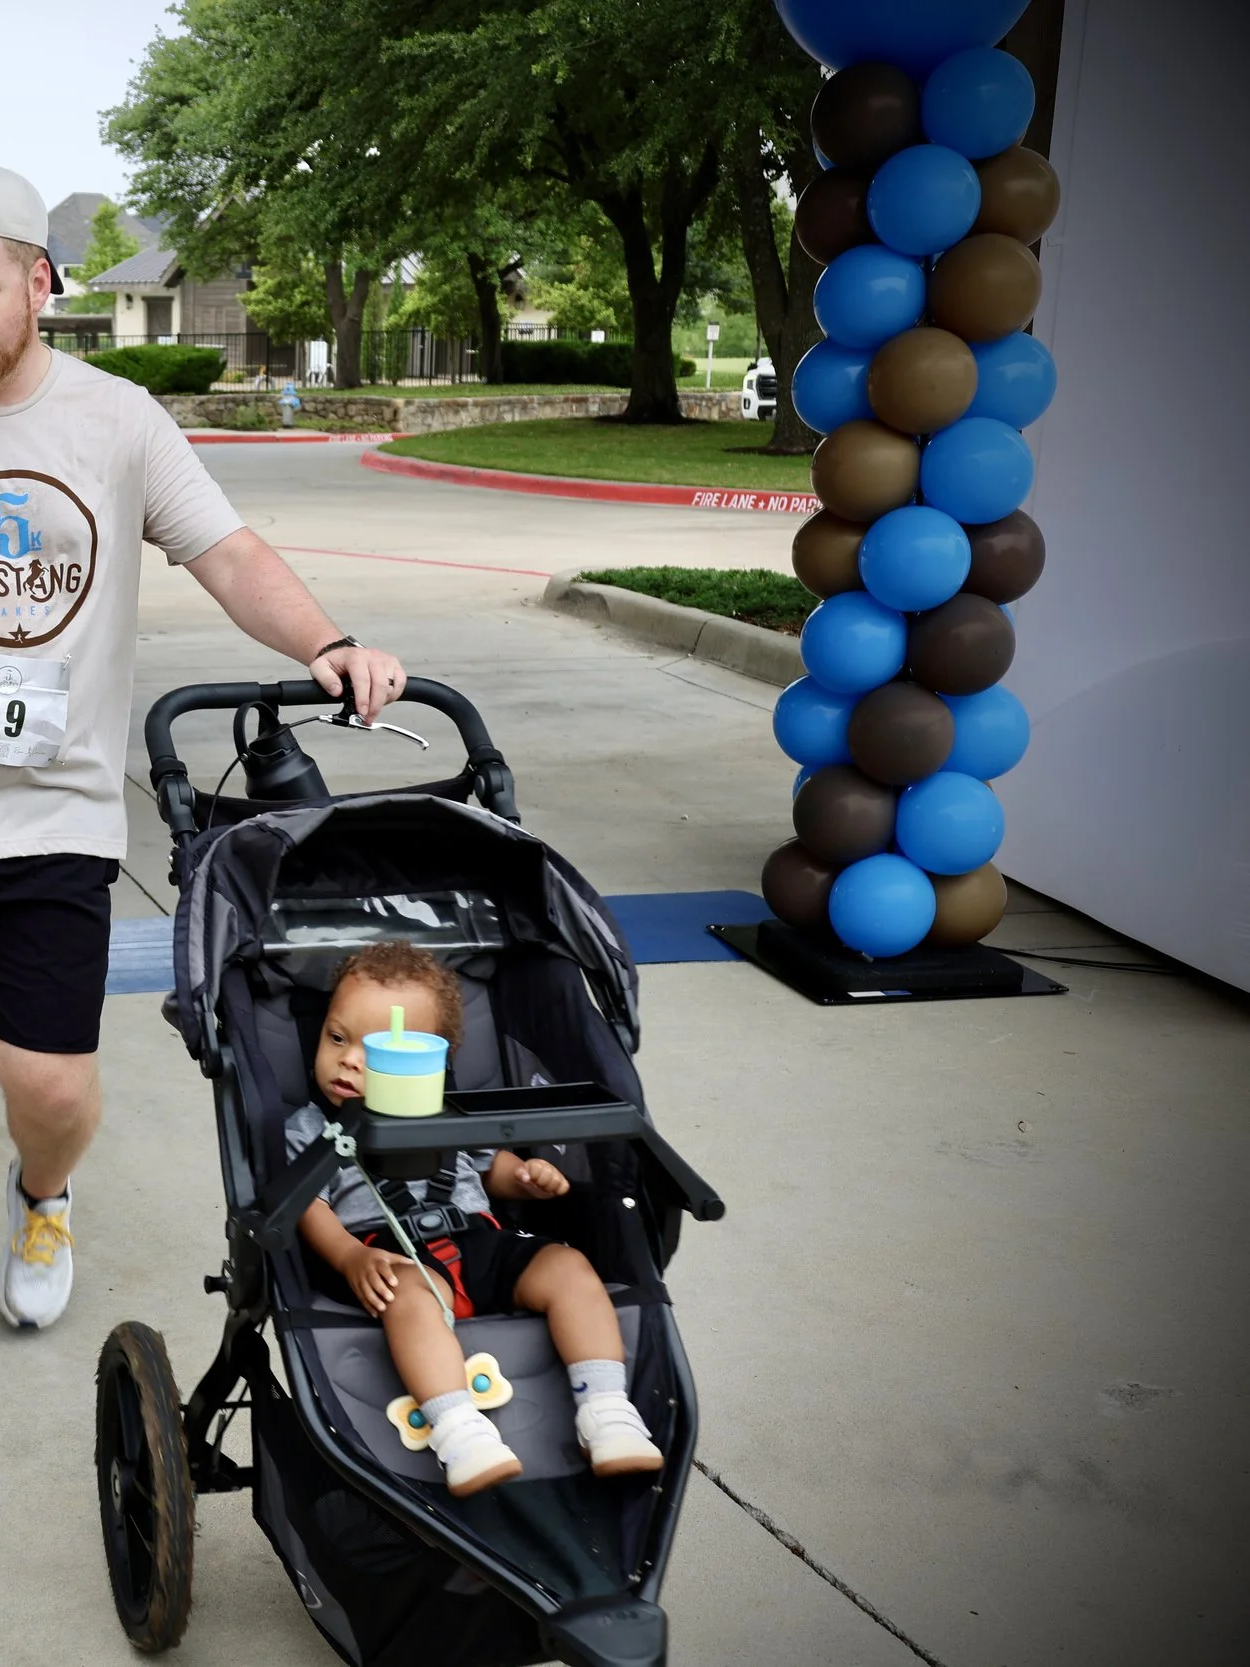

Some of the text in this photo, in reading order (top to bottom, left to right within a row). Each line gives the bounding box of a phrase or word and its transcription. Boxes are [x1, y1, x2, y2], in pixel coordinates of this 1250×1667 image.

[692, 492, 721, 507] FIRE
[721, 494, 756, 510] LANE
[768, 496, 787, 511] NO
